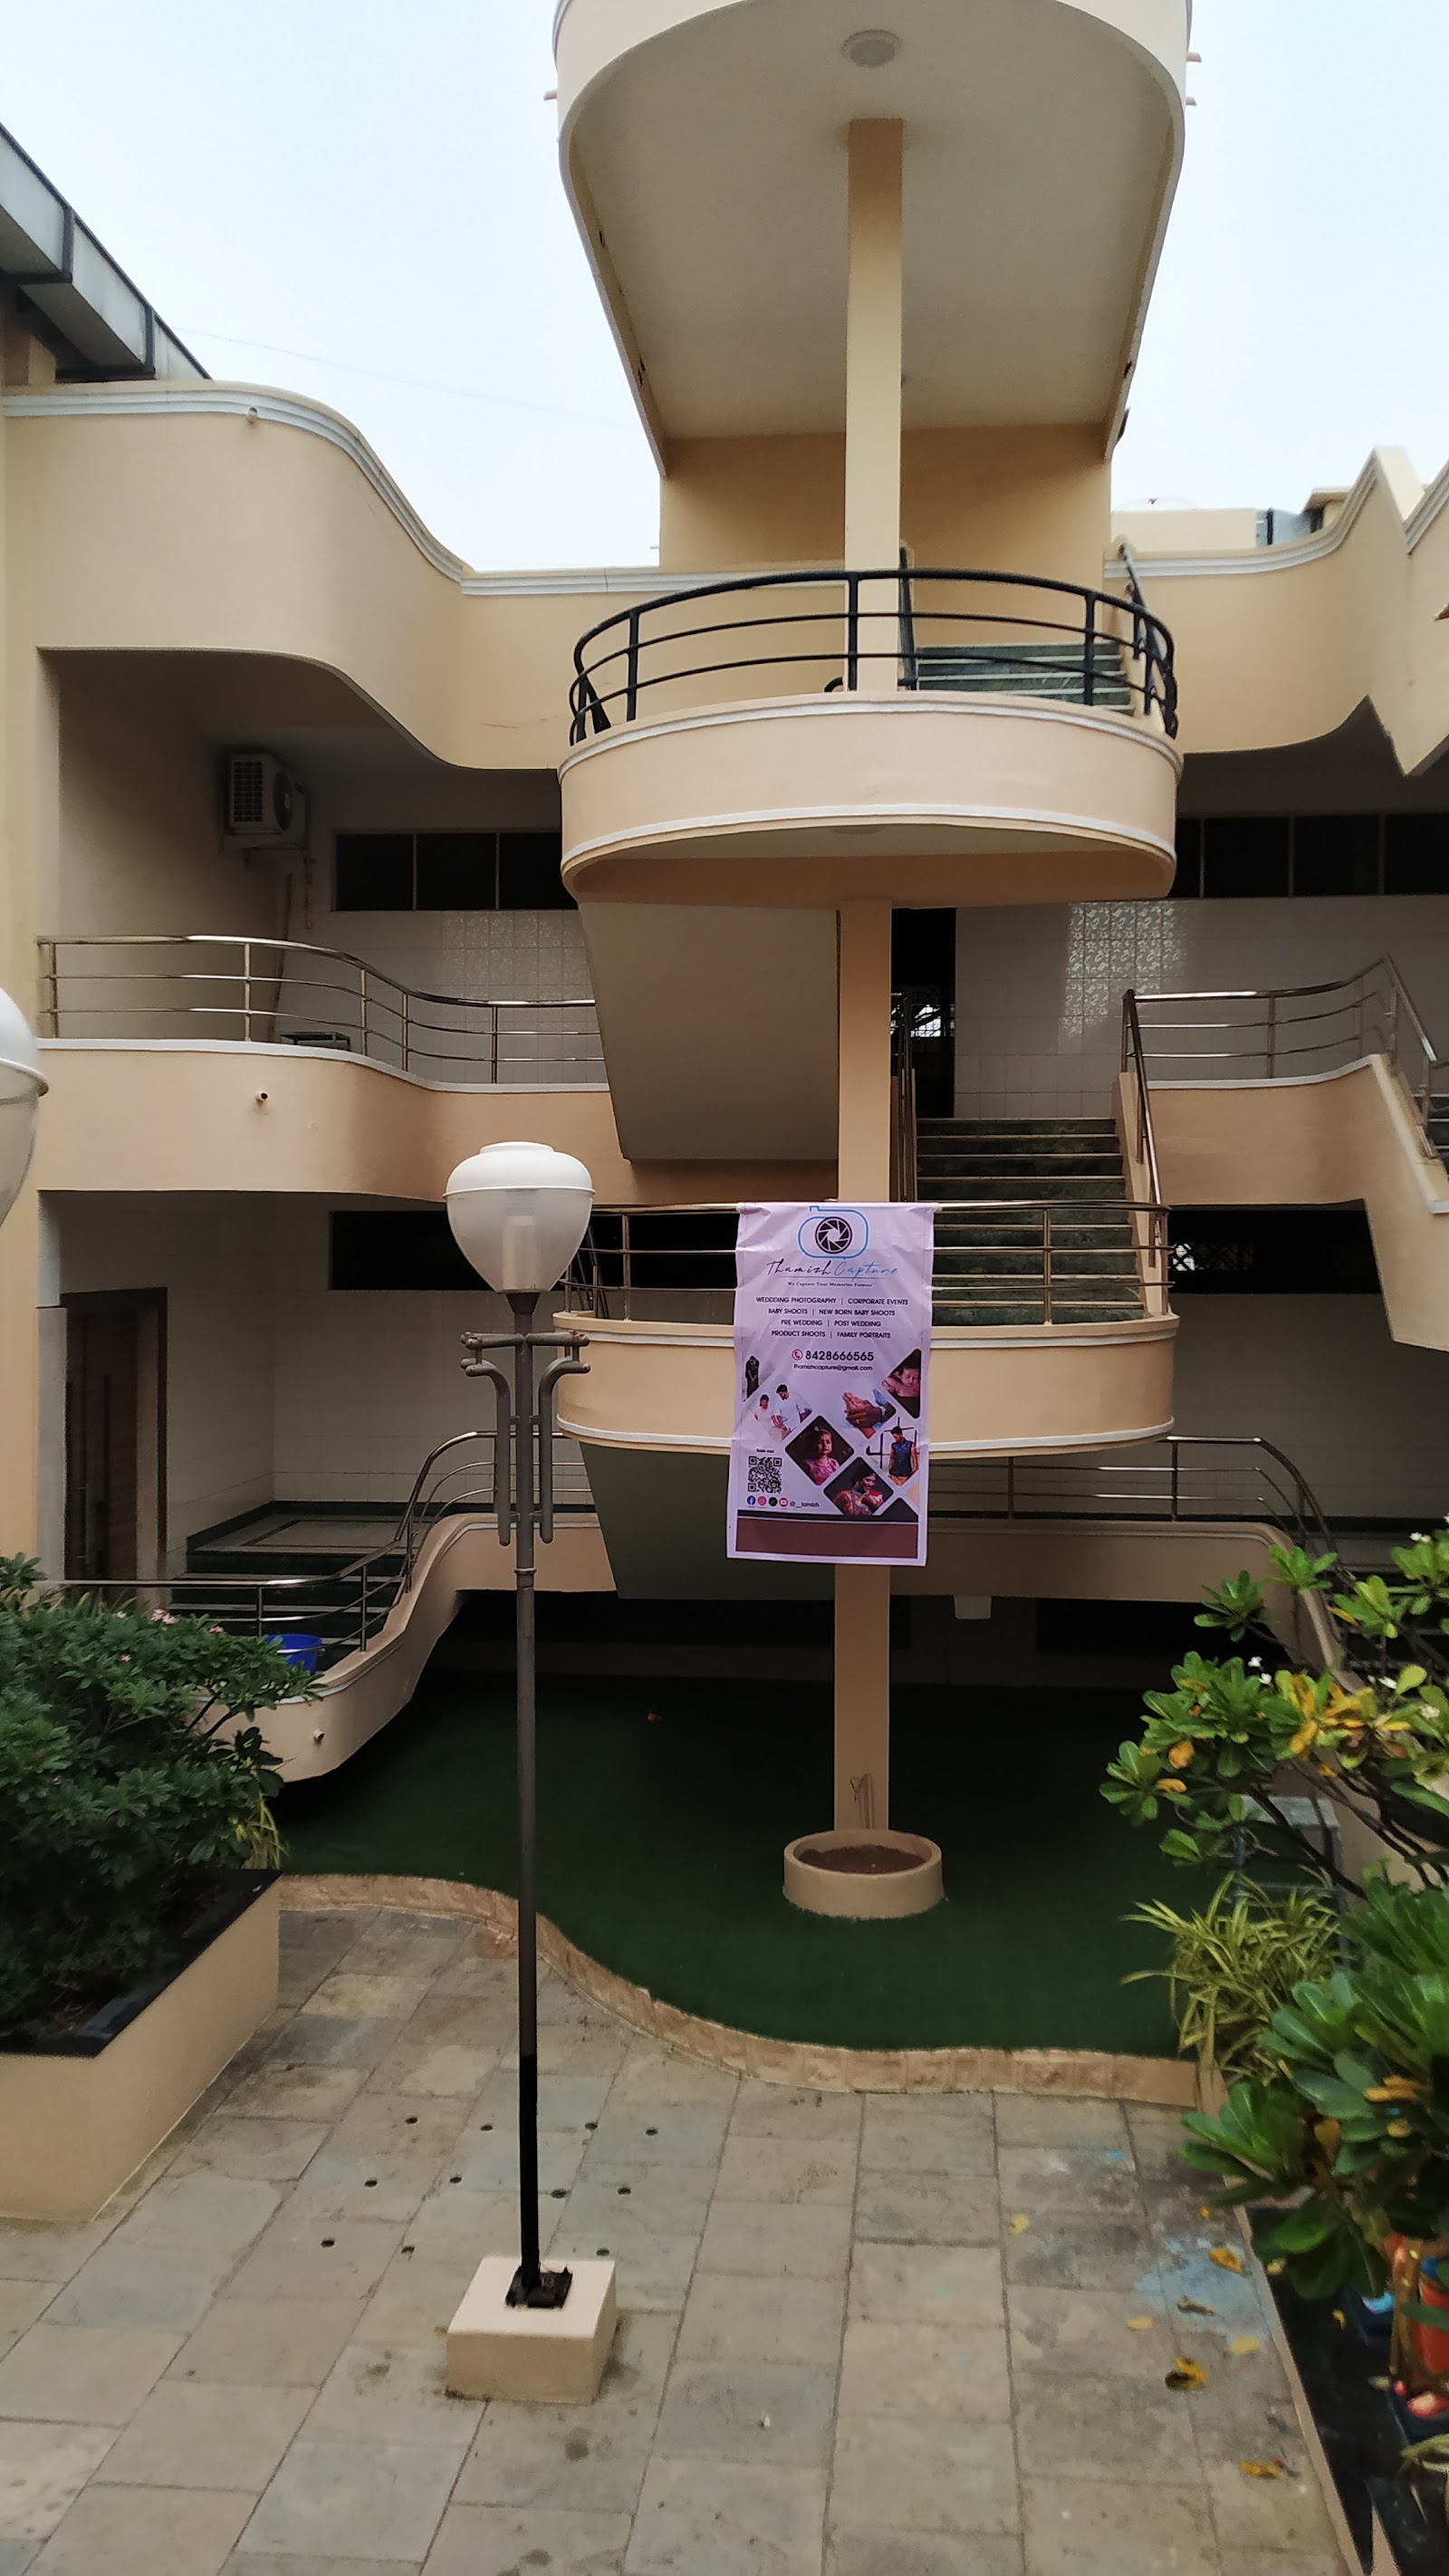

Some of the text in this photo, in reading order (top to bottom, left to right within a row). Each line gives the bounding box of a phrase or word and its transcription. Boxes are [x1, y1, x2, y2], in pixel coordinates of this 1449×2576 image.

[767, 1258, 898, 1282] Thamizh Capture
[805, 1350, 875, 1361] 8428666565
[793, 1363, 874, 1371] thamizhcapture@gmail.com
